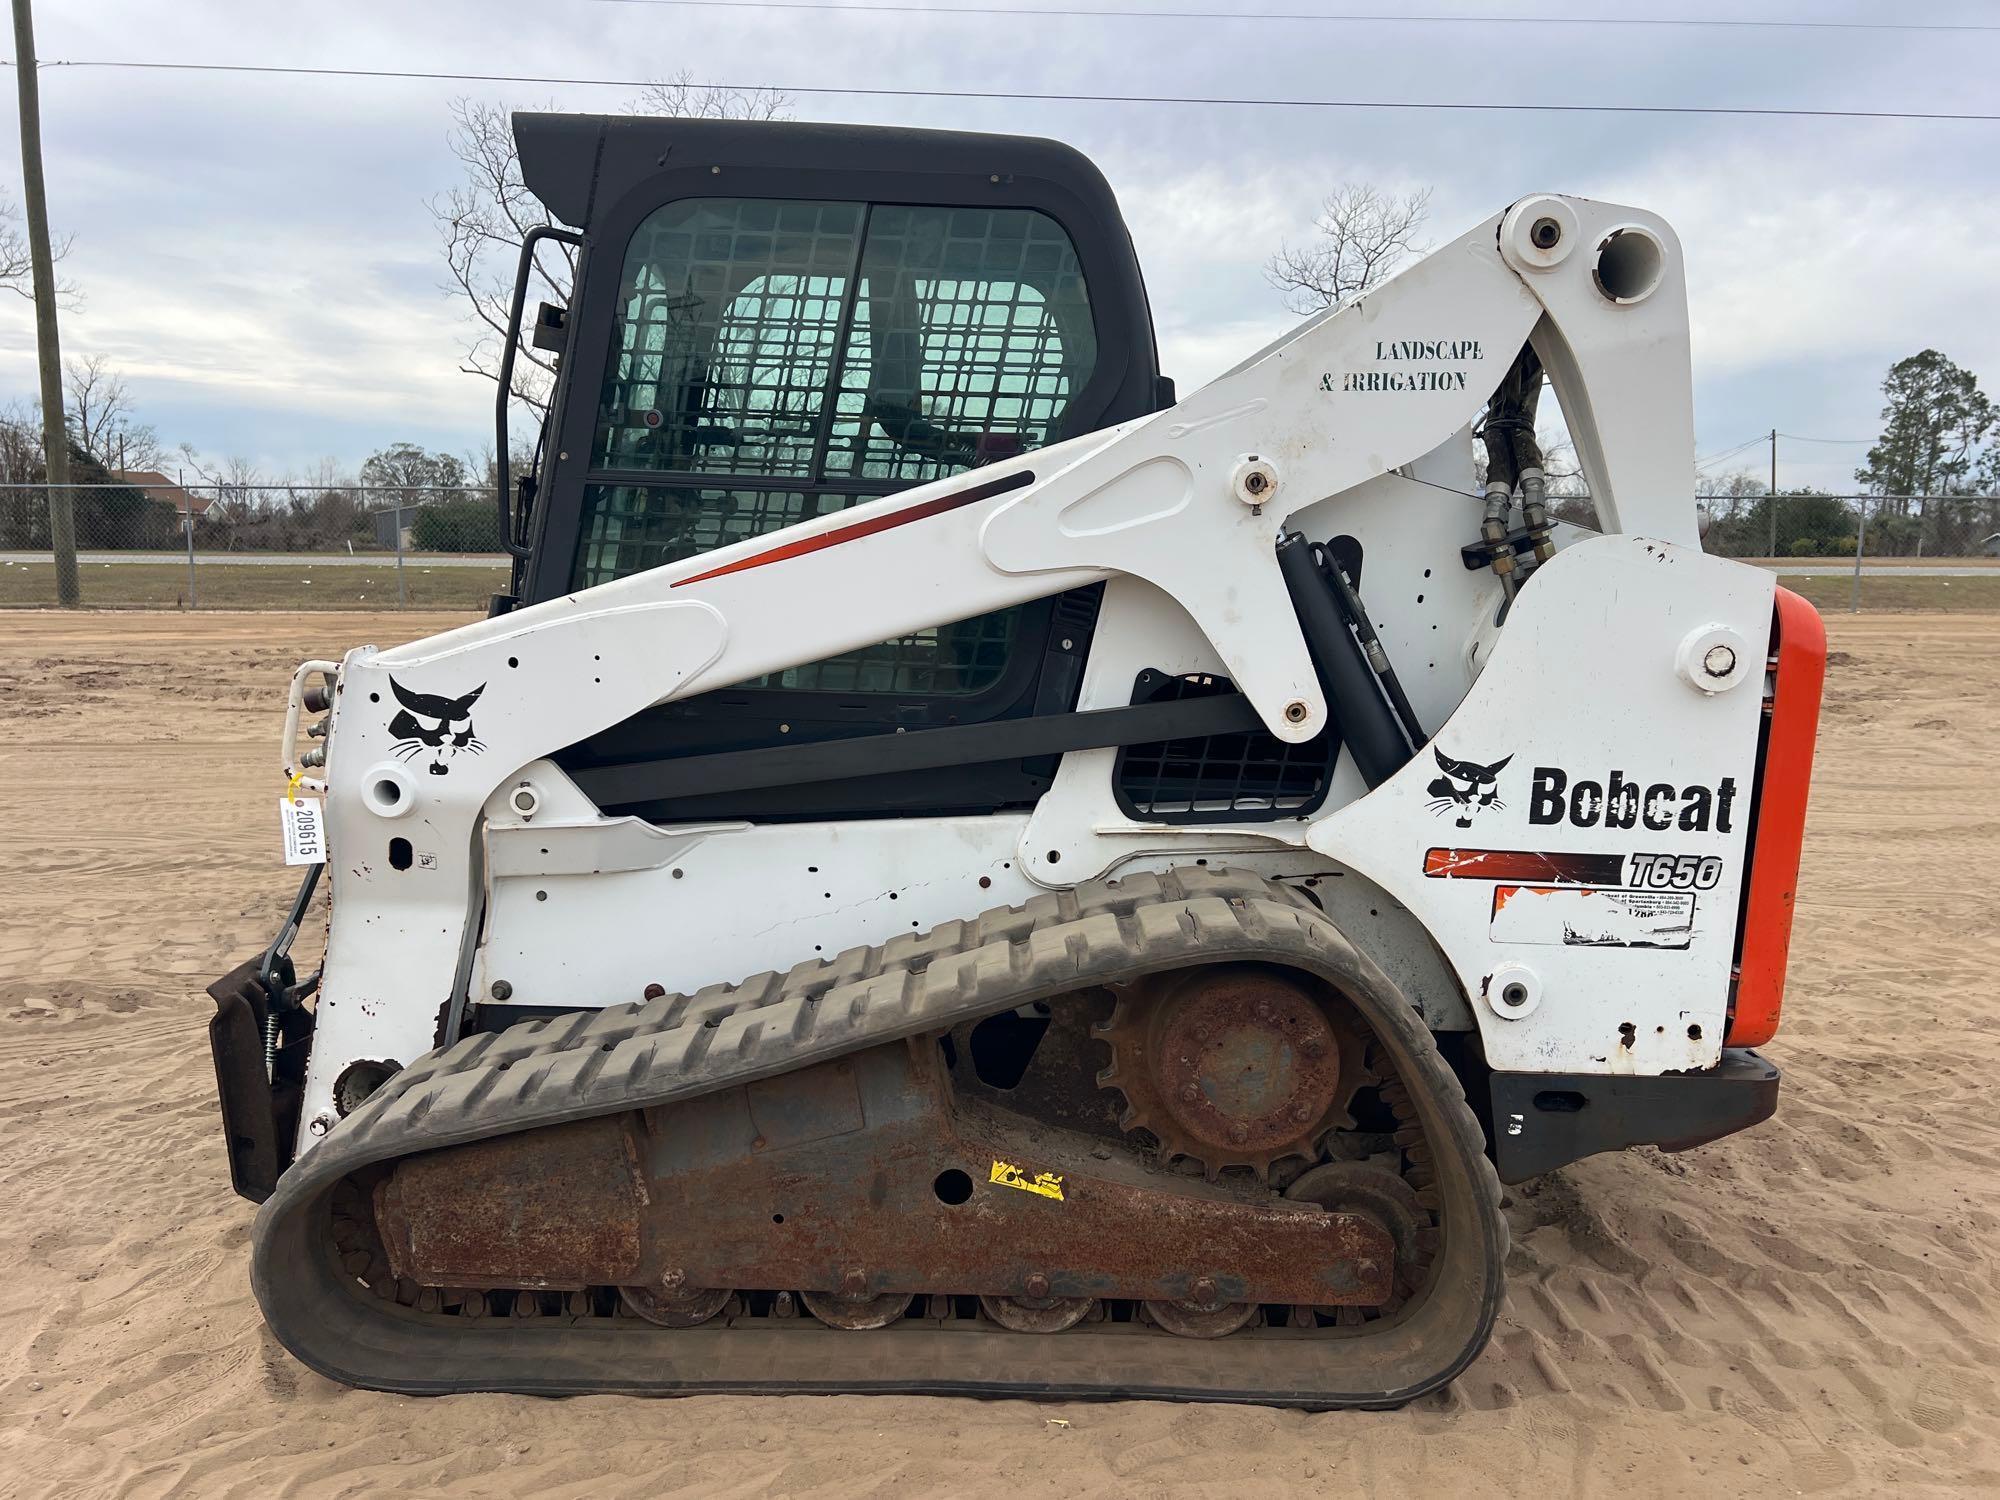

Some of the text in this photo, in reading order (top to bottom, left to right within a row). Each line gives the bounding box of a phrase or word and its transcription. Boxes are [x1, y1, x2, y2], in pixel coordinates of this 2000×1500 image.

[1375, 340, 1484, 360] LANDSCAPE
[1319, 371, 1467, 391] & IRRIGATION
[1529, 766, 1737, 834] Bobcat
[296, 810, 317, 855] 209615
[1629, 852, 1723, 890] T650
